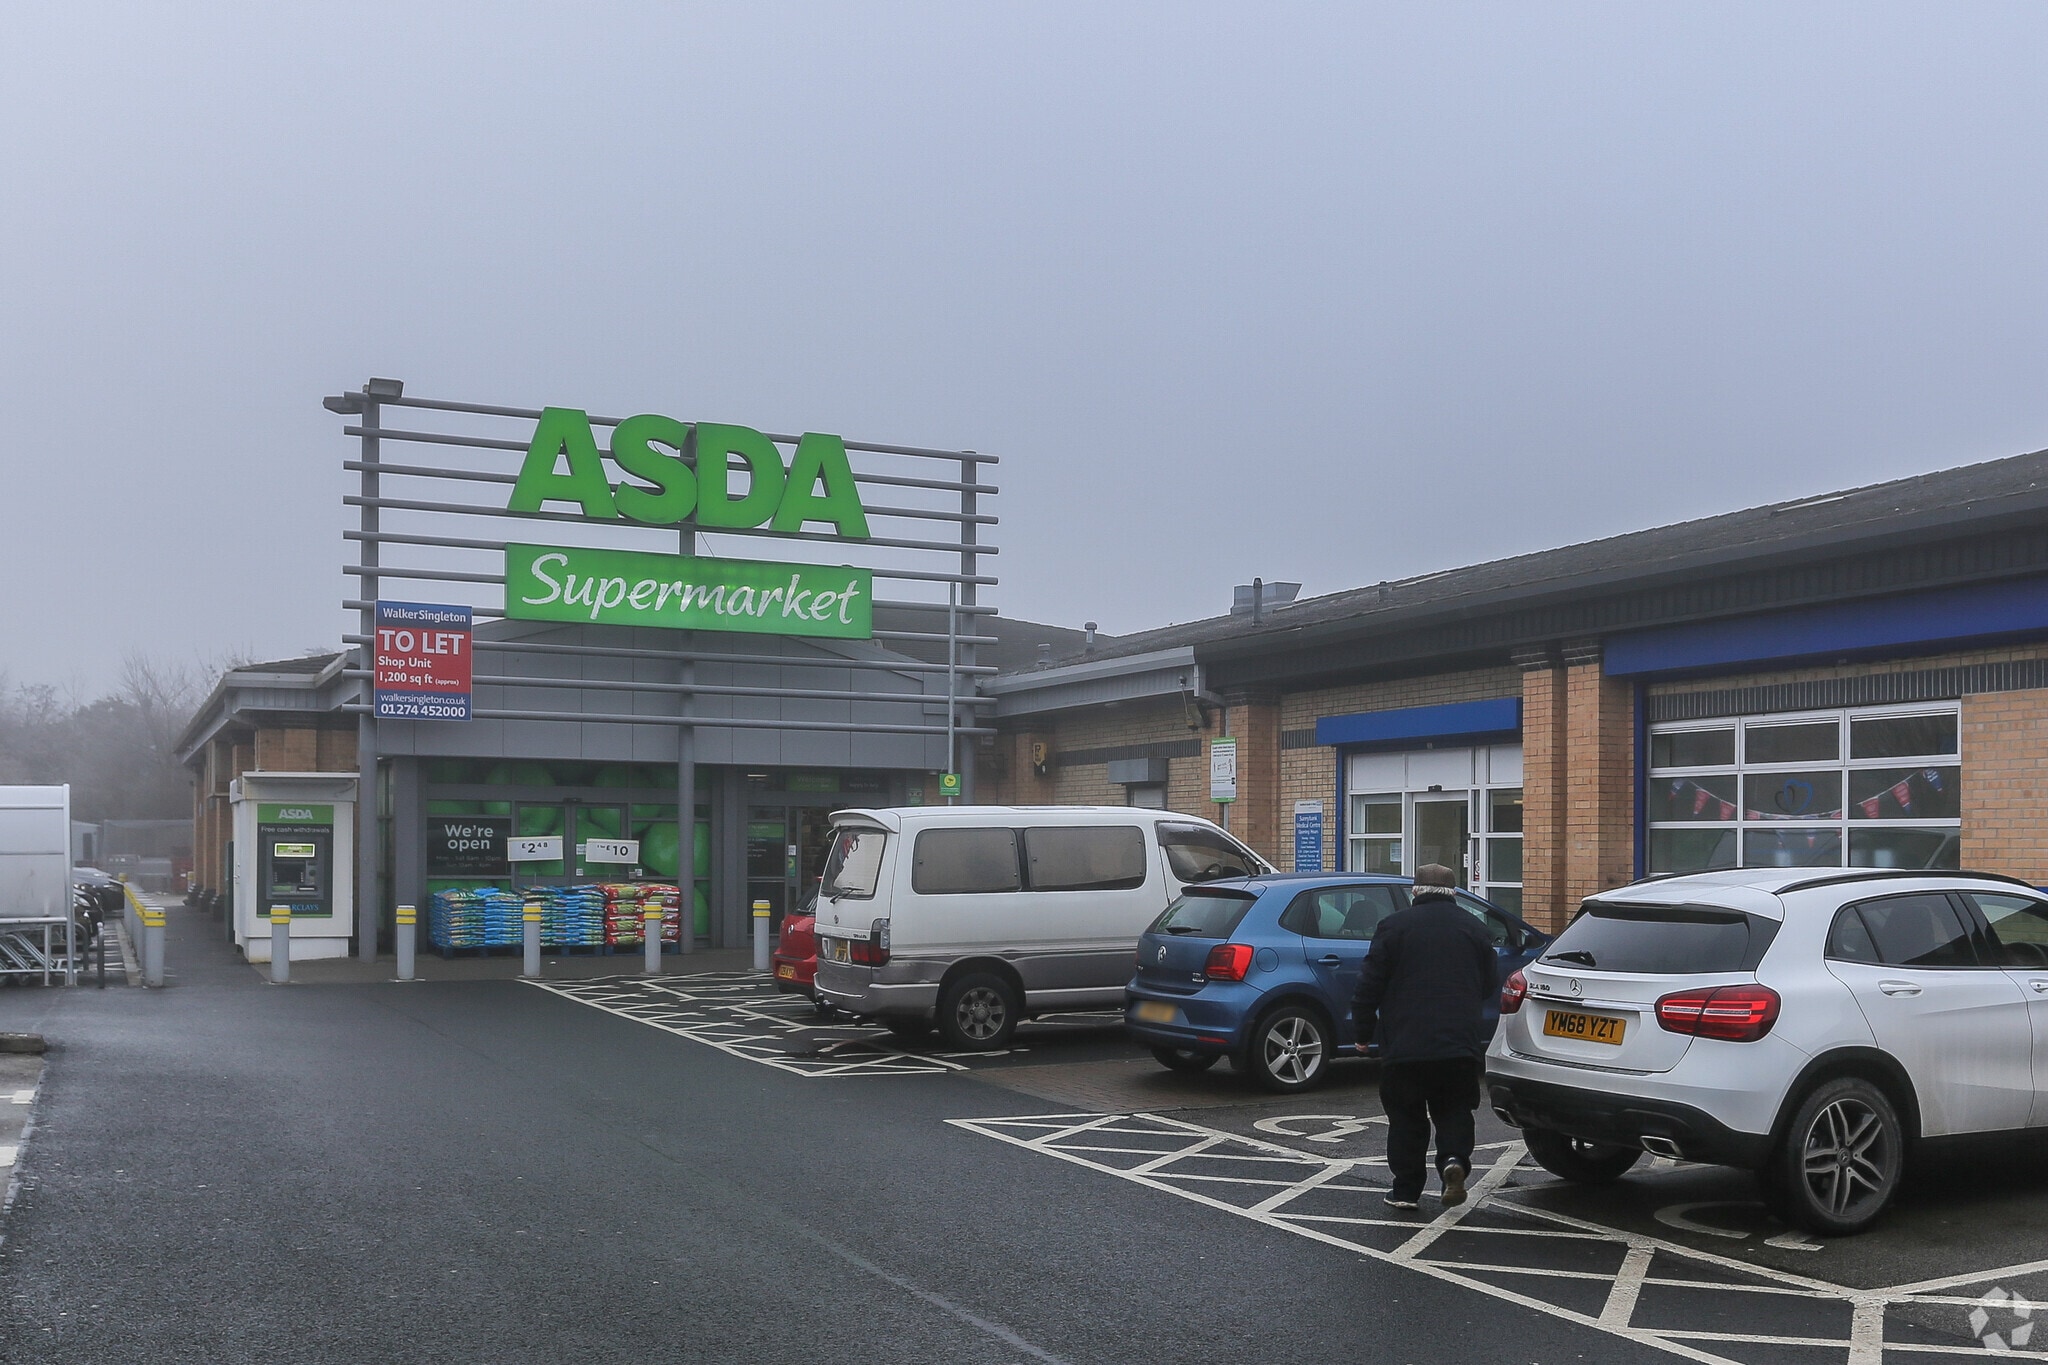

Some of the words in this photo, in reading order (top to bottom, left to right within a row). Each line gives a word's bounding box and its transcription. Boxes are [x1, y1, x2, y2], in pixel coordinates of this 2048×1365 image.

[506, 406, 871, 539] ASDA
[522, 552, 860, 625] Supermarket
[379, 629, 415, 653] TO
[422, 632, 465, 655] LET
[378, 656, 406, 669] Shop
[408, 657, 432, 668] Unit
[379, 671, 407, 683] 1,200
[409, 675, 422, 686] sq
[424, 674, 433, 684] ft
[380, 693, 466, 706] walkersingleton.co.uk
[278, 808, 314, 820] ASDA
[293, 826, 330, 834] withdrawals
[447, 839, 491, 852] open
[1551, 1012, 1587, 1034] YM68
[1590, 1016, 1619, 1039] YZT
